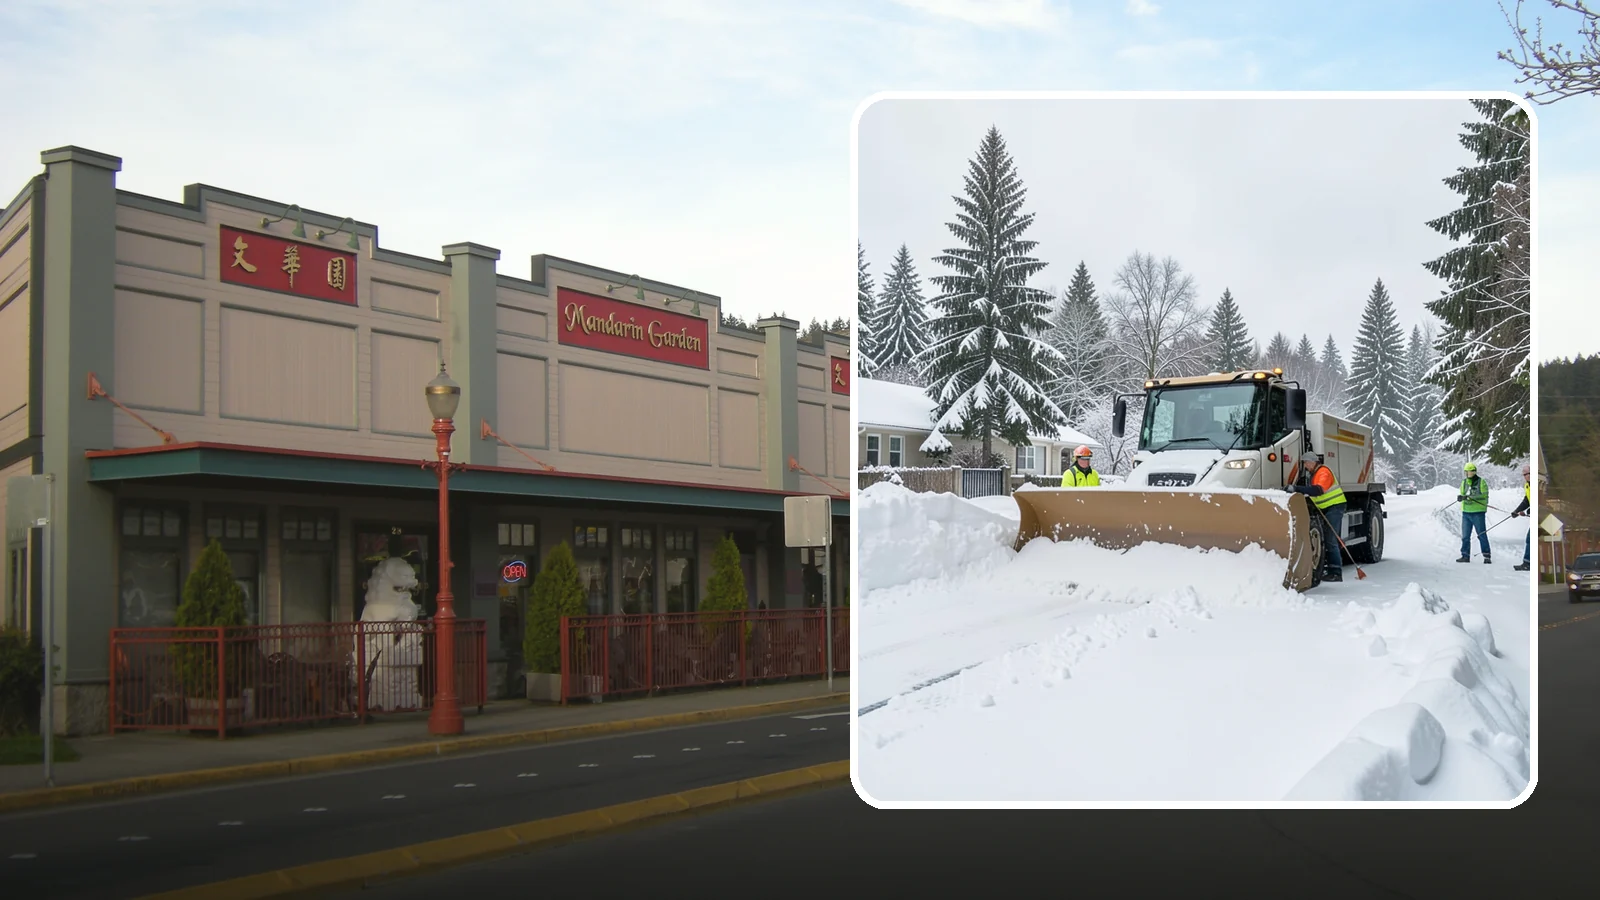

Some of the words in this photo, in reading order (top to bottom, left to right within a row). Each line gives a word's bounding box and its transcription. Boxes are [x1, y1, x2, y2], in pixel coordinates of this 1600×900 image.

[564, 302, 644, 340] Mandarin
[648, 320, 701, 352] Garden
[503, 565, 527, 578] OPEN
